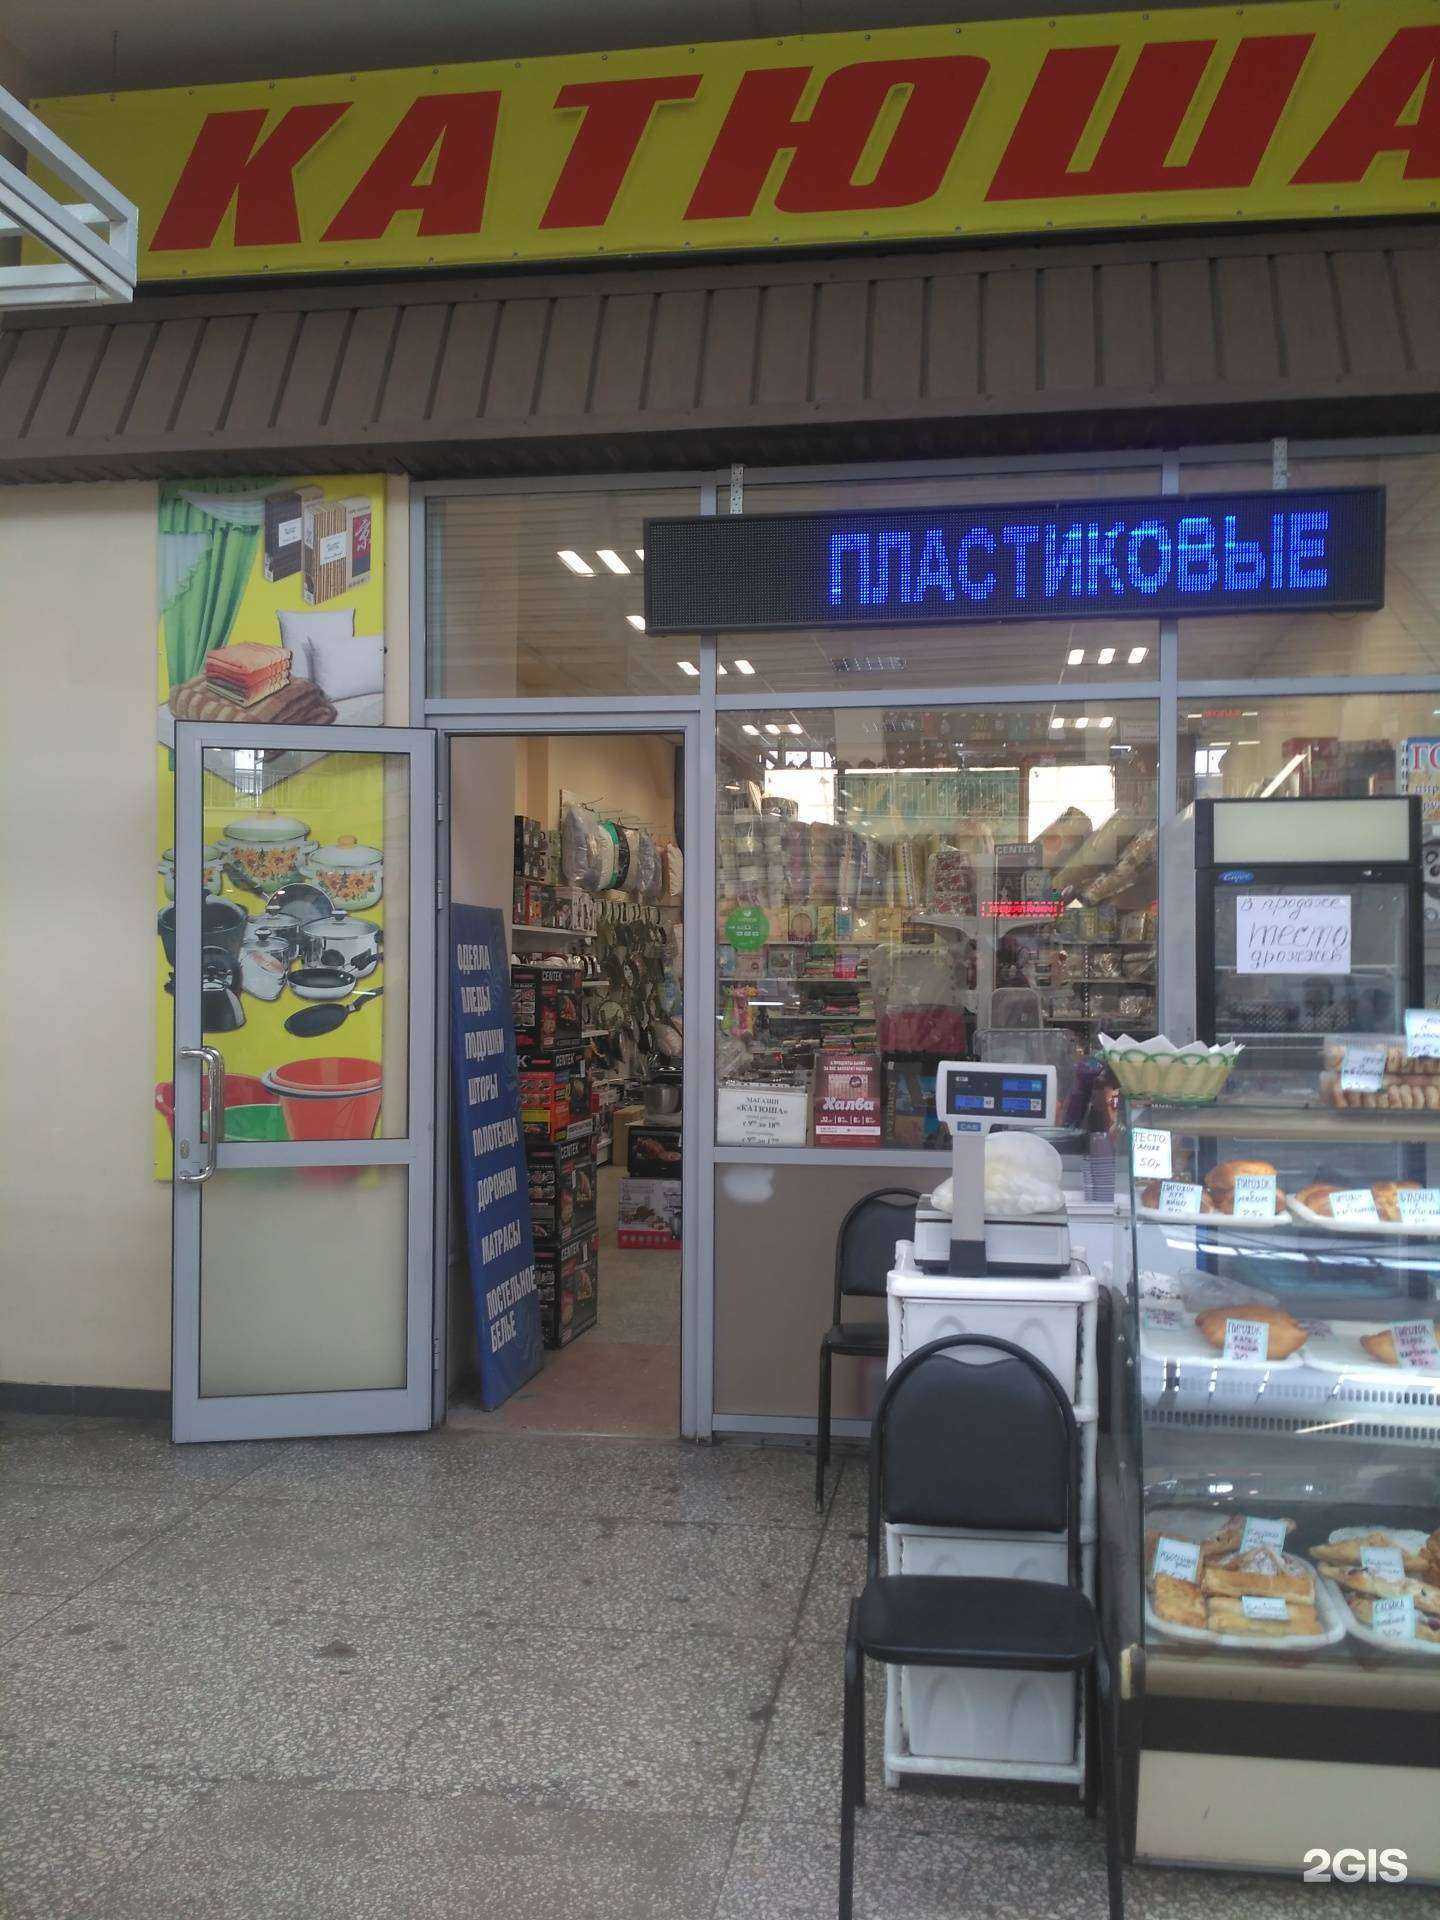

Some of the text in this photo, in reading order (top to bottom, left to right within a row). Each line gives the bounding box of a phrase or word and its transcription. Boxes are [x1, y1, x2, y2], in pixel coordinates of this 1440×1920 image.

[148, 25, 1440, 252] КАТЮША
[828, 510, 1329, 605] ПЛАСТИКОВЫЕ
[457, 943, 491, 974] ОДЕЯЛА
[461, 986, 491, 1017] ПЛЕДЫ
[464, 1028, 505, 1062] ПОДУШКИ
[468, 1073, 499, 1106] ШТОРЫ
[822, 1096, 875, 1111] Халва
[472, 1117, 519, 1157] ПОЛОТЕНЦА
[477, 1166, 518, 1212] ДОРОЖКИ
[481, 1219, 521, 1265] МАТРАСЫ
[486, 1264, 537, 1320] ПОСТЕЛЬНОЕ
[490, 1309, 517, 1353] БЕЛЬЕ
